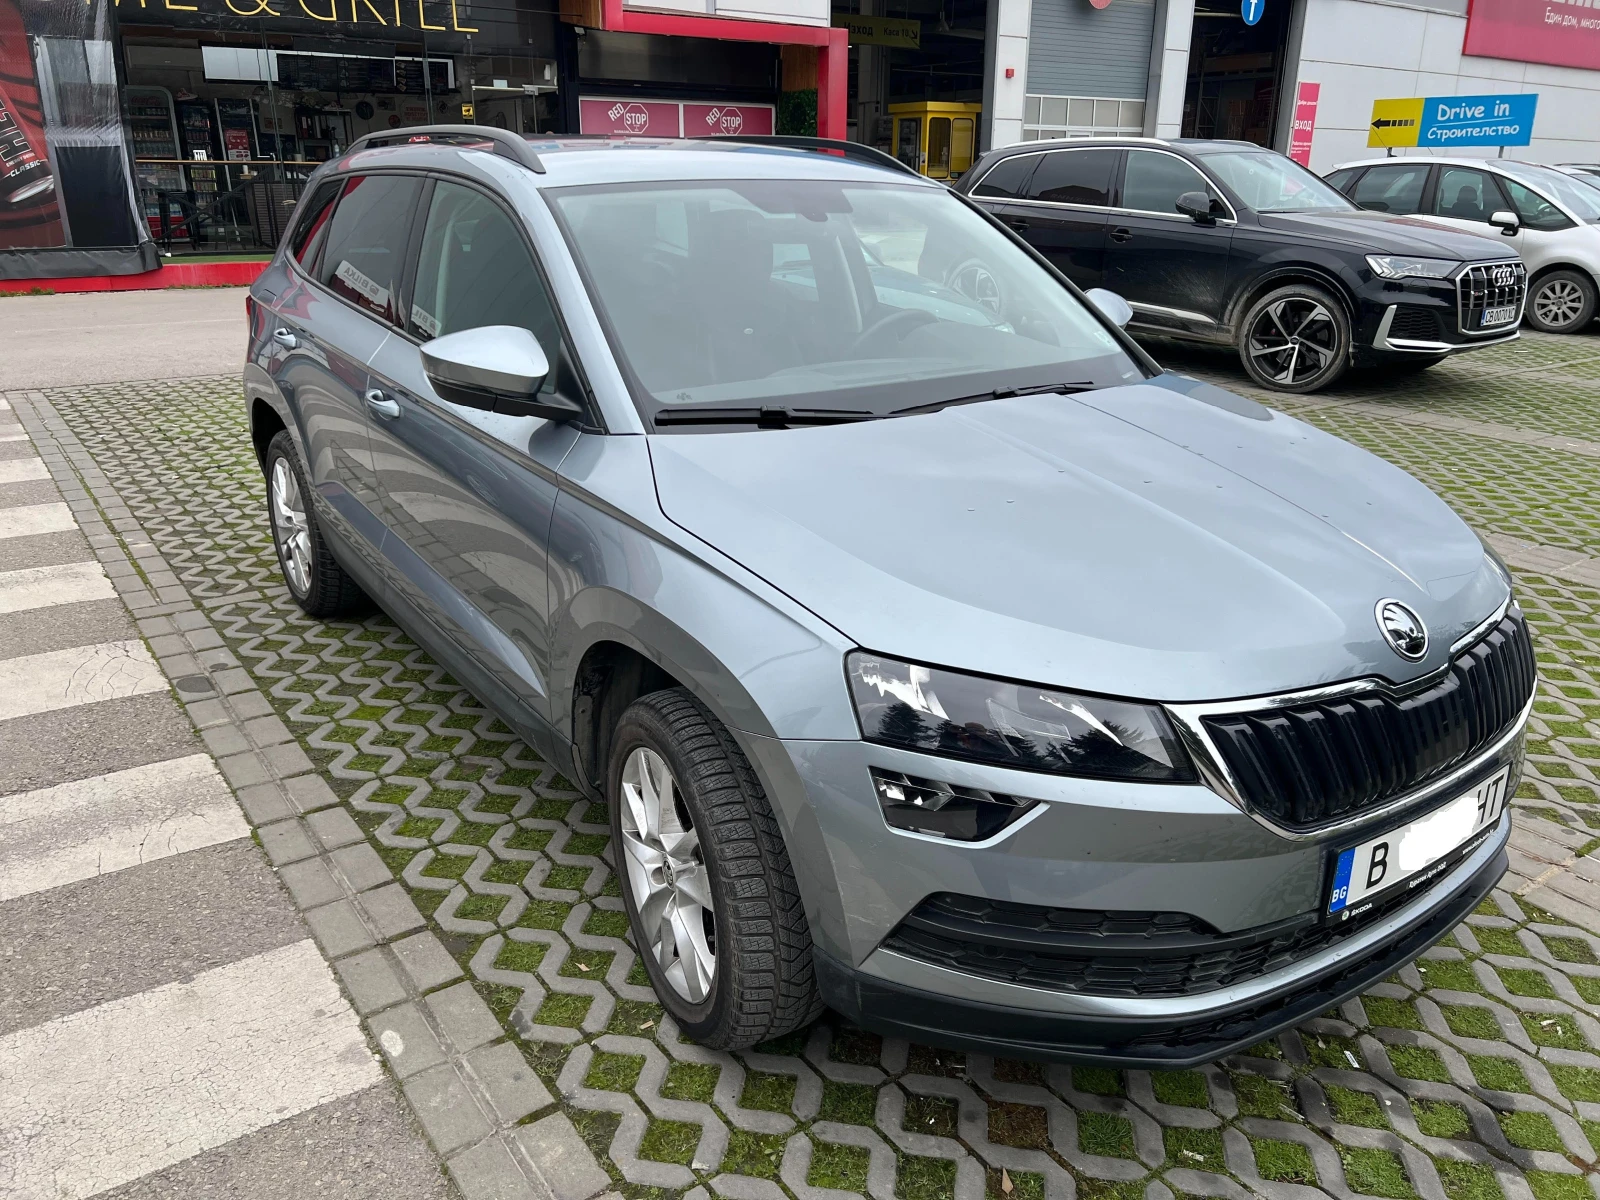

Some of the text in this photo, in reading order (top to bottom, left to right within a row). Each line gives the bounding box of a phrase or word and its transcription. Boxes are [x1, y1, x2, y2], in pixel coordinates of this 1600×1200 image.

[1545, 7, 1563, 24] Един
[608, 103, 647, 125] RED STOP
[705, 108, 741, 128] RED STOP
[1437, 100, 1510, 121] Drive in
[1295, 120, 1312, 132] ВХОД
[1428, 125, 1519, 142] Строителство
[10, 159, 41, 177] CLASSIC
[1331, 885, 1348, 903] BG
